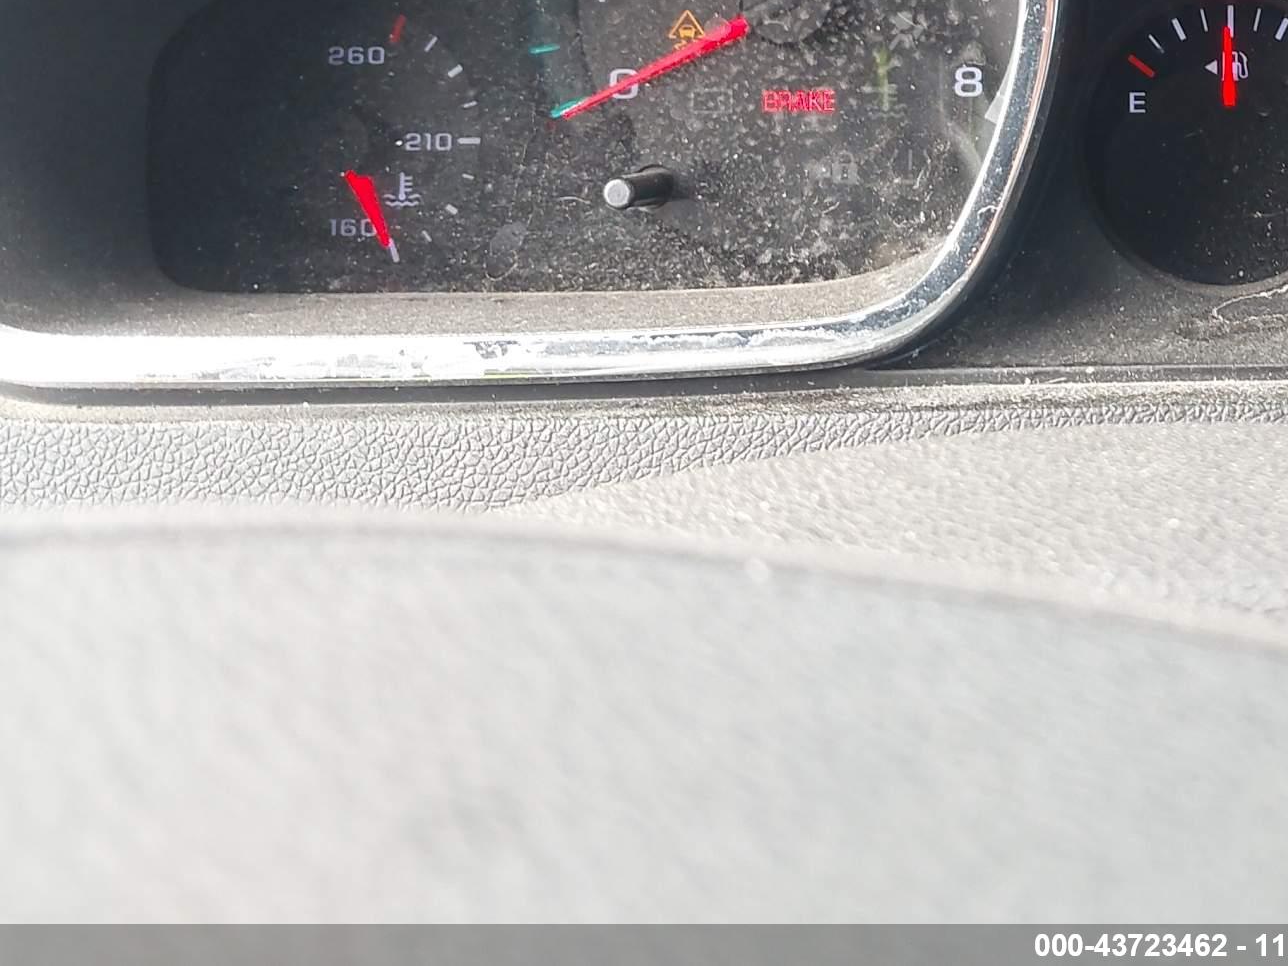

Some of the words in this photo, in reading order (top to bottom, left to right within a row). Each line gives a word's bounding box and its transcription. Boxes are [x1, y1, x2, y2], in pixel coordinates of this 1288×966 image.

[328, 46, 385, 65] 260
[954, 66, 983, 96] 8
[762, 90, 836, 114] BRAKE
[1129, 92, 1146, 113] E
[405, 133, 452, 151] 210
